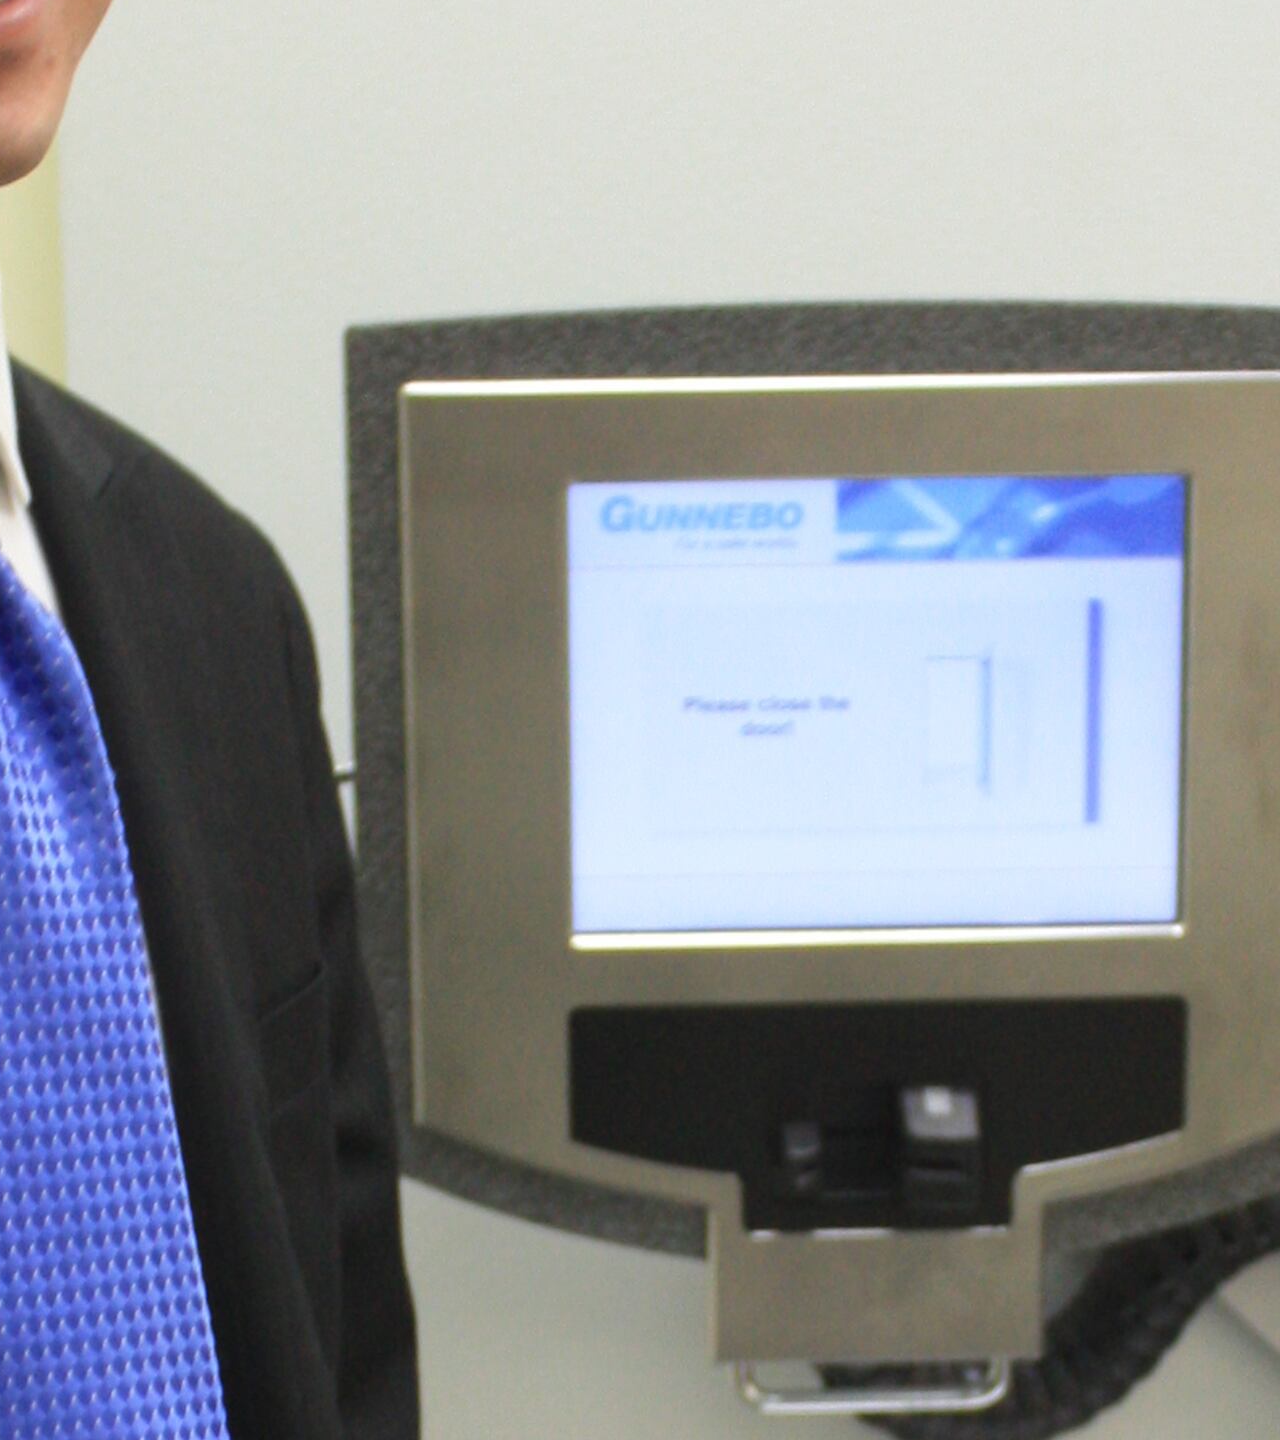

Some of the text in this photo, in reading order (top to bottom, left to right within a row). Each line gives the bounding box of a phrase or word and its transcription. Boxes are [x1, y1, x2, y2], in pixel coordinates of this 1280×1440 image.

[601, 494, 804, 532] GUNNEBO
[683, 696, 749, 711] Please
[757, 696, 811, 710] close
